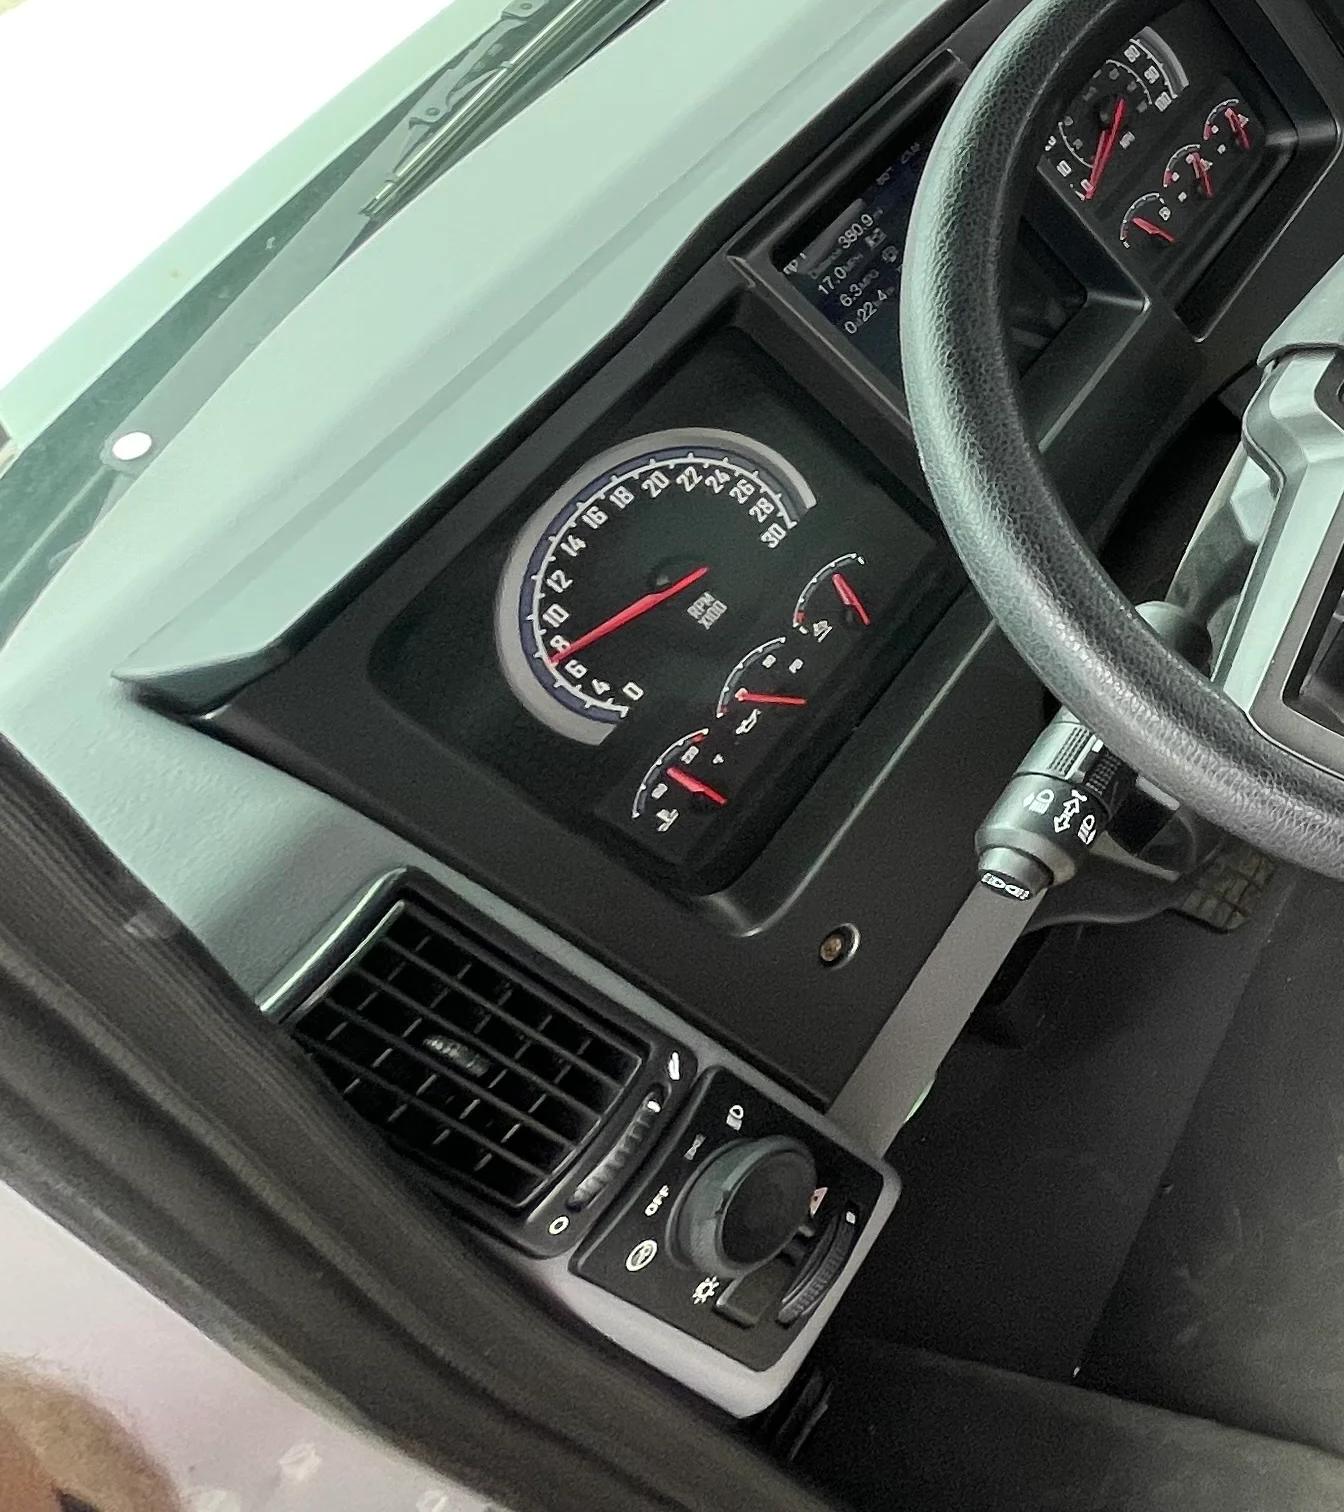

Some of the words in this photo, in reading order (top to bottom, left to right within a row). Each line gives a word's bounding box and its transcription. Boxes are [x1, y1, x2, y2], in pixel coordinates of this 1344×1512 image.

[641, 470, 671, 498] 20
[676, 466, 703, 492] 22
[705, 469, 731, 494] 24
[729, 478, 755, 505] 26
[609, 485, 635, 509] 18
[582, 506, 608, 529] 16
[749, 497, 776, 523] 28
[560, 535, 587, 557] 14
[761, 522, 787, 549] 30
[546, 569, 573, 594] 12
[542, 603, 570, 628] 10
[687, 590, 717, 619] RPM
[550, 634, 571, 653] 8
[564, 659, 588, 679] 6
[622, 681, 644, 701] 0
[644, 1184, 670, 1217] OFF
